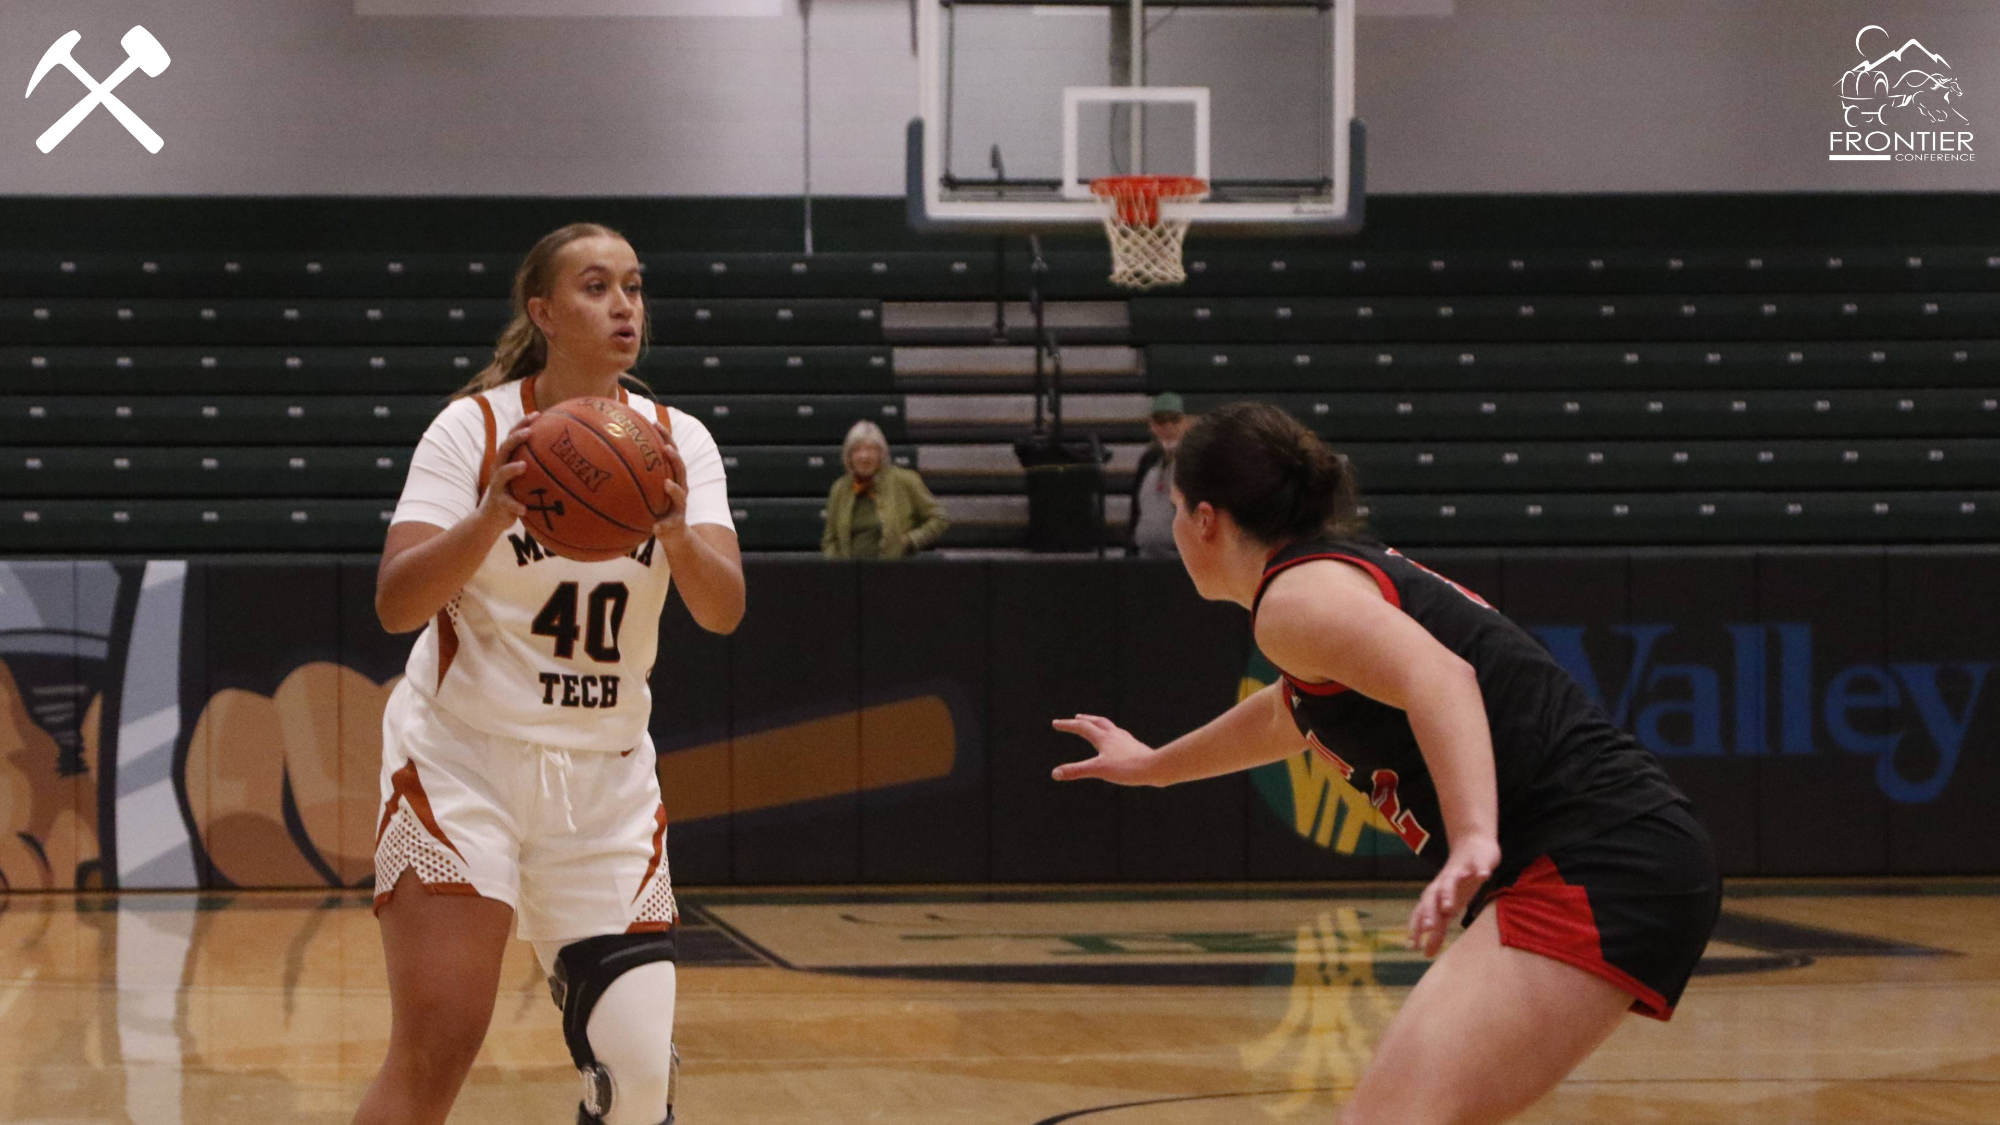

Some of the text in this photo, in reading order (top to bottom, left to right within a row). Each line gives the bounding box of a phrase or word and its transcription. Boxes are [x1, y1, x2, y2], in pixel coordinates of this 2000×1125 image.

[550, 428, 610, 492] NAIA
[531, 581, 629, 663] 40
[539, 672, 621, 709] TECH
[1531, 623, 1993, 804] Valley
